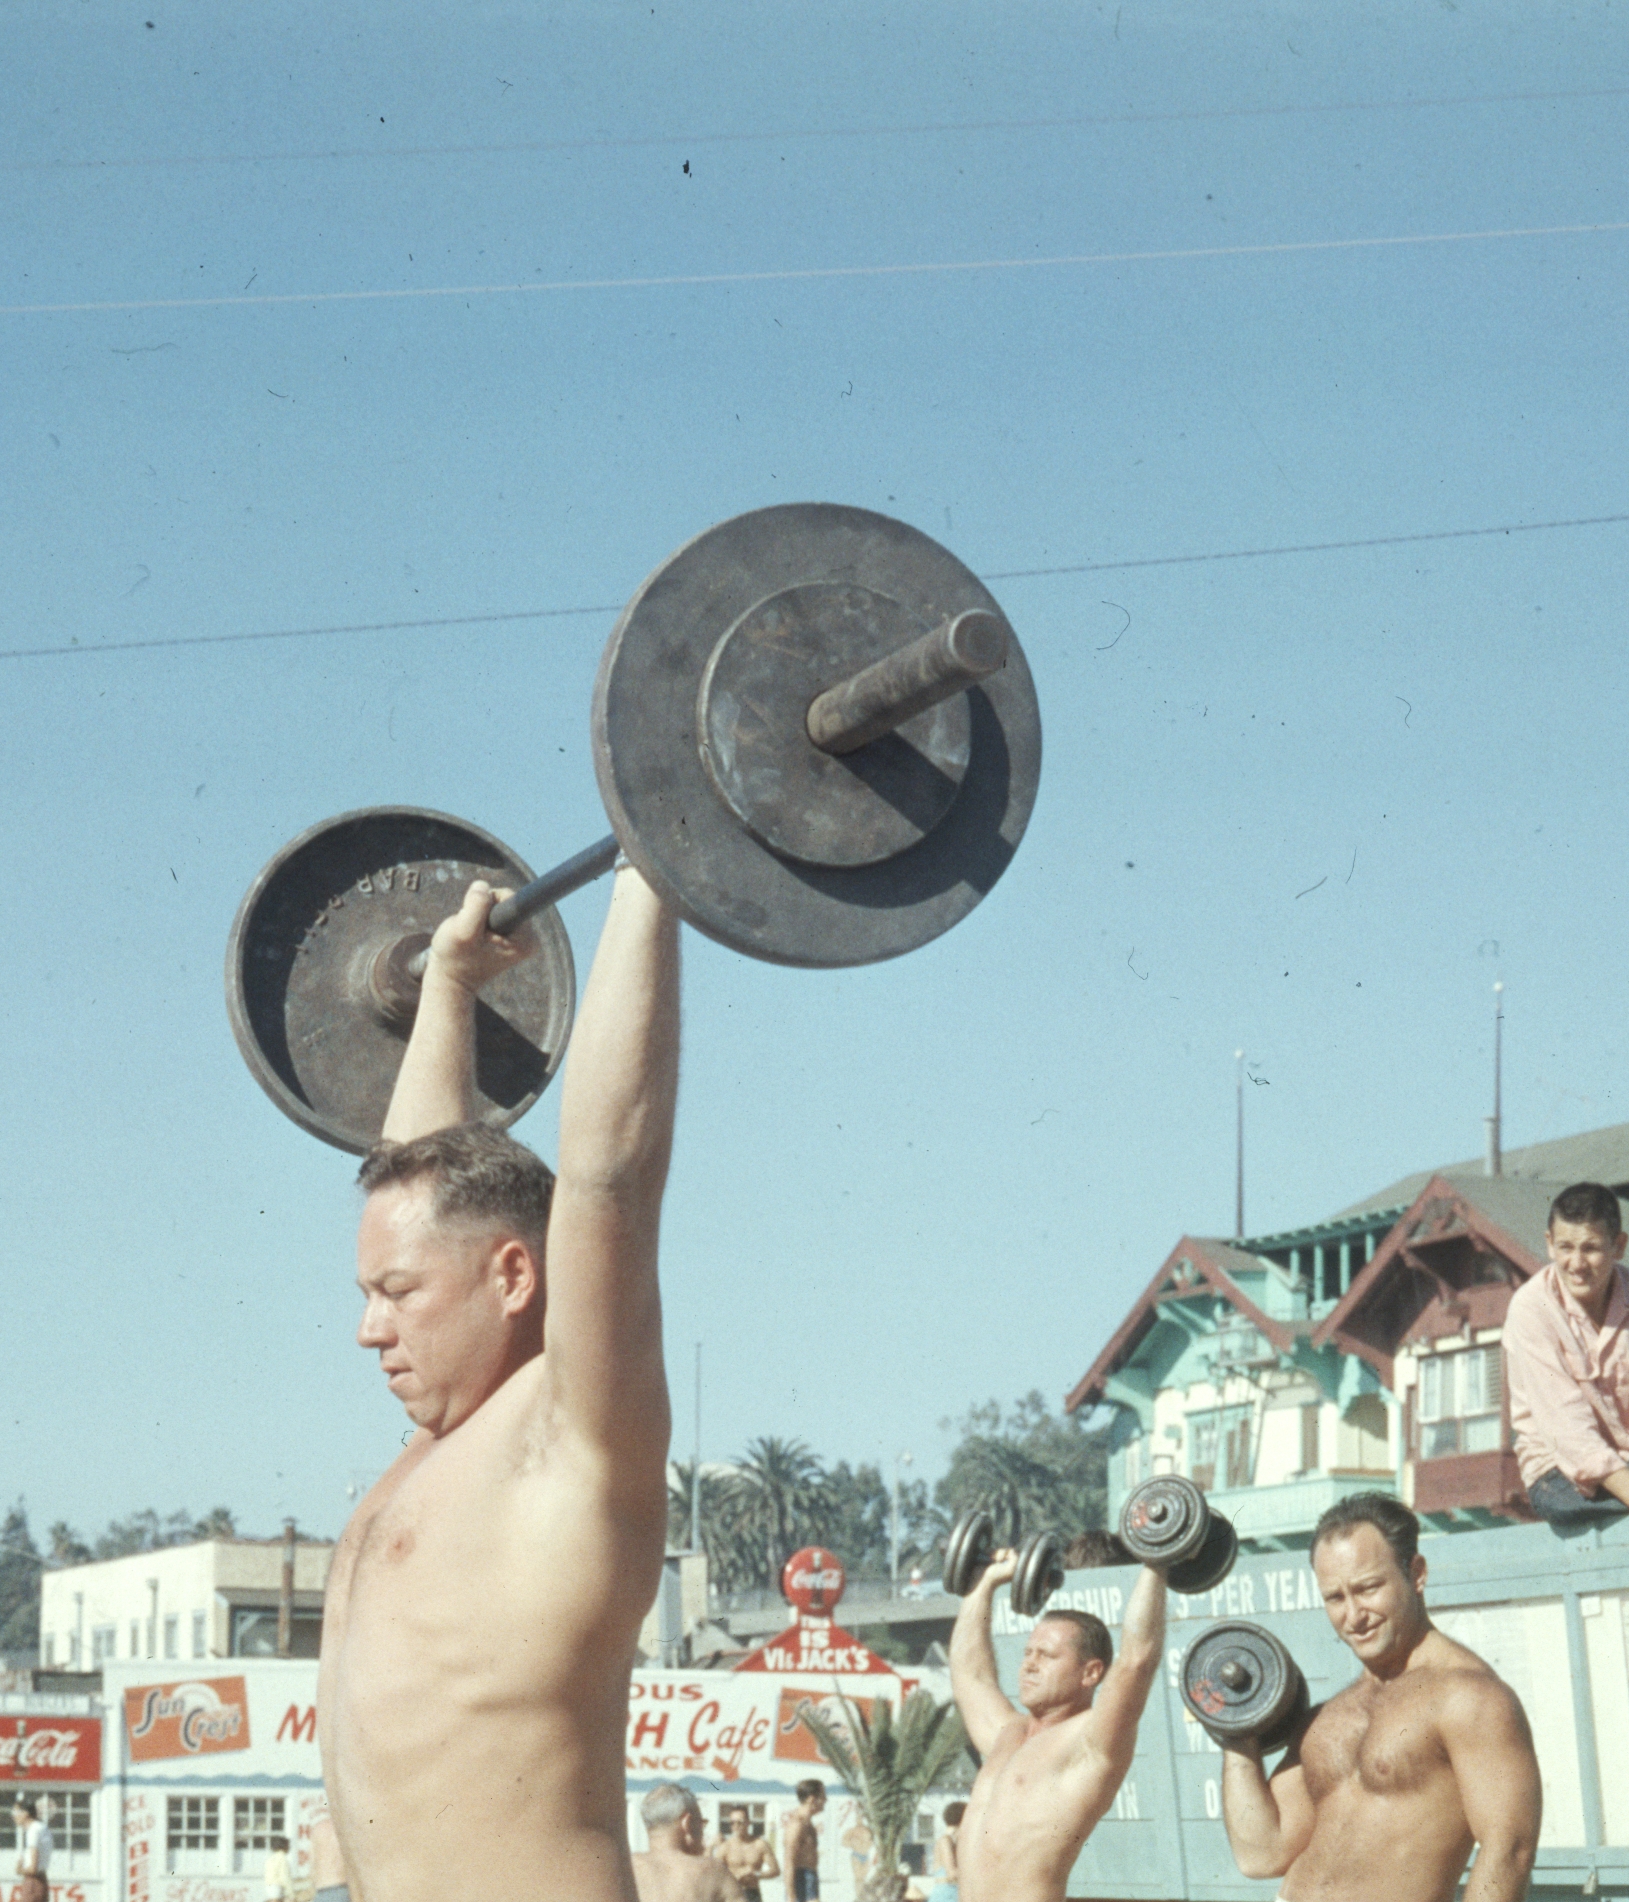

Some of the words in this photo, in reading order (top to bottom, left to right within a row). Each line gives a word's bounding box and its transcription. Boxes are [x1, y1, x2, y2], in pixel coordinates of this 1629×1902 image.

[1210, 1573, 1255, 1617] PER
[796, 1645, 870, 1671] JACK'S
[798, 1629, 831, 1648] IS
[132, 1689, 187, 1738] Sun
[181, 1705, 242, 1753] Crest
